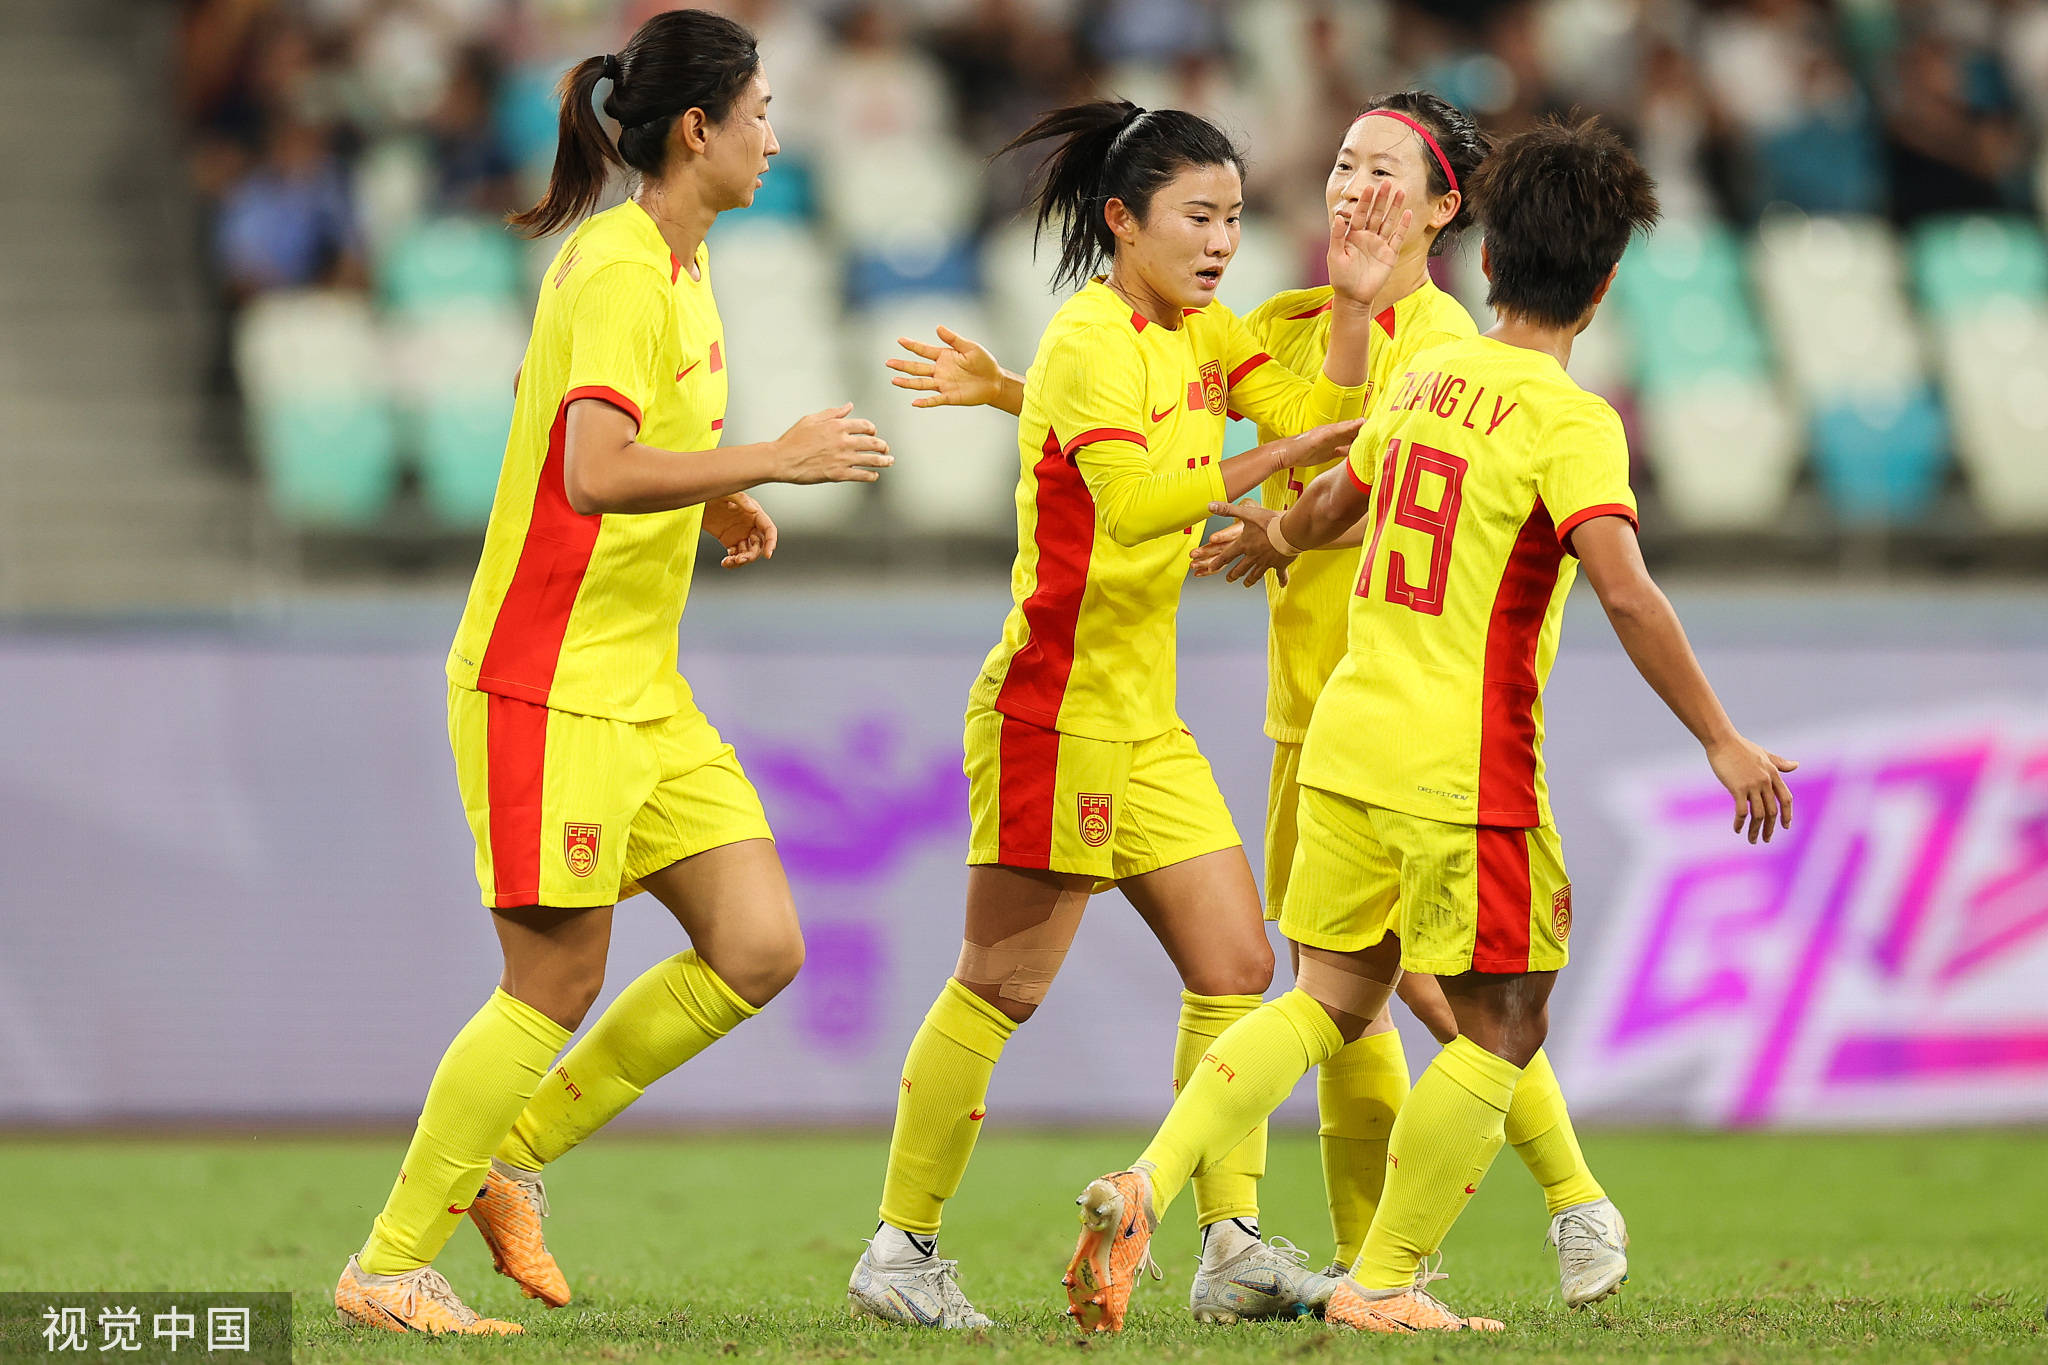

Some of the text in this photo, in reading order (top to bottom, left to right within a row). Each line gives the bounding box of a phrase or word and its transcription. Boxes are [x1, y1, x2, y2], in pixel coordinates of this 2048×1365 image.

[1201, 364, 1218, 380] CFA
[1390, 371, 1466, 419] ZHANG
[1355, 438, 1469, 617] 19
[1081, 797, 1108, 808] CFA
[568, 826, 597, 838] CFA
